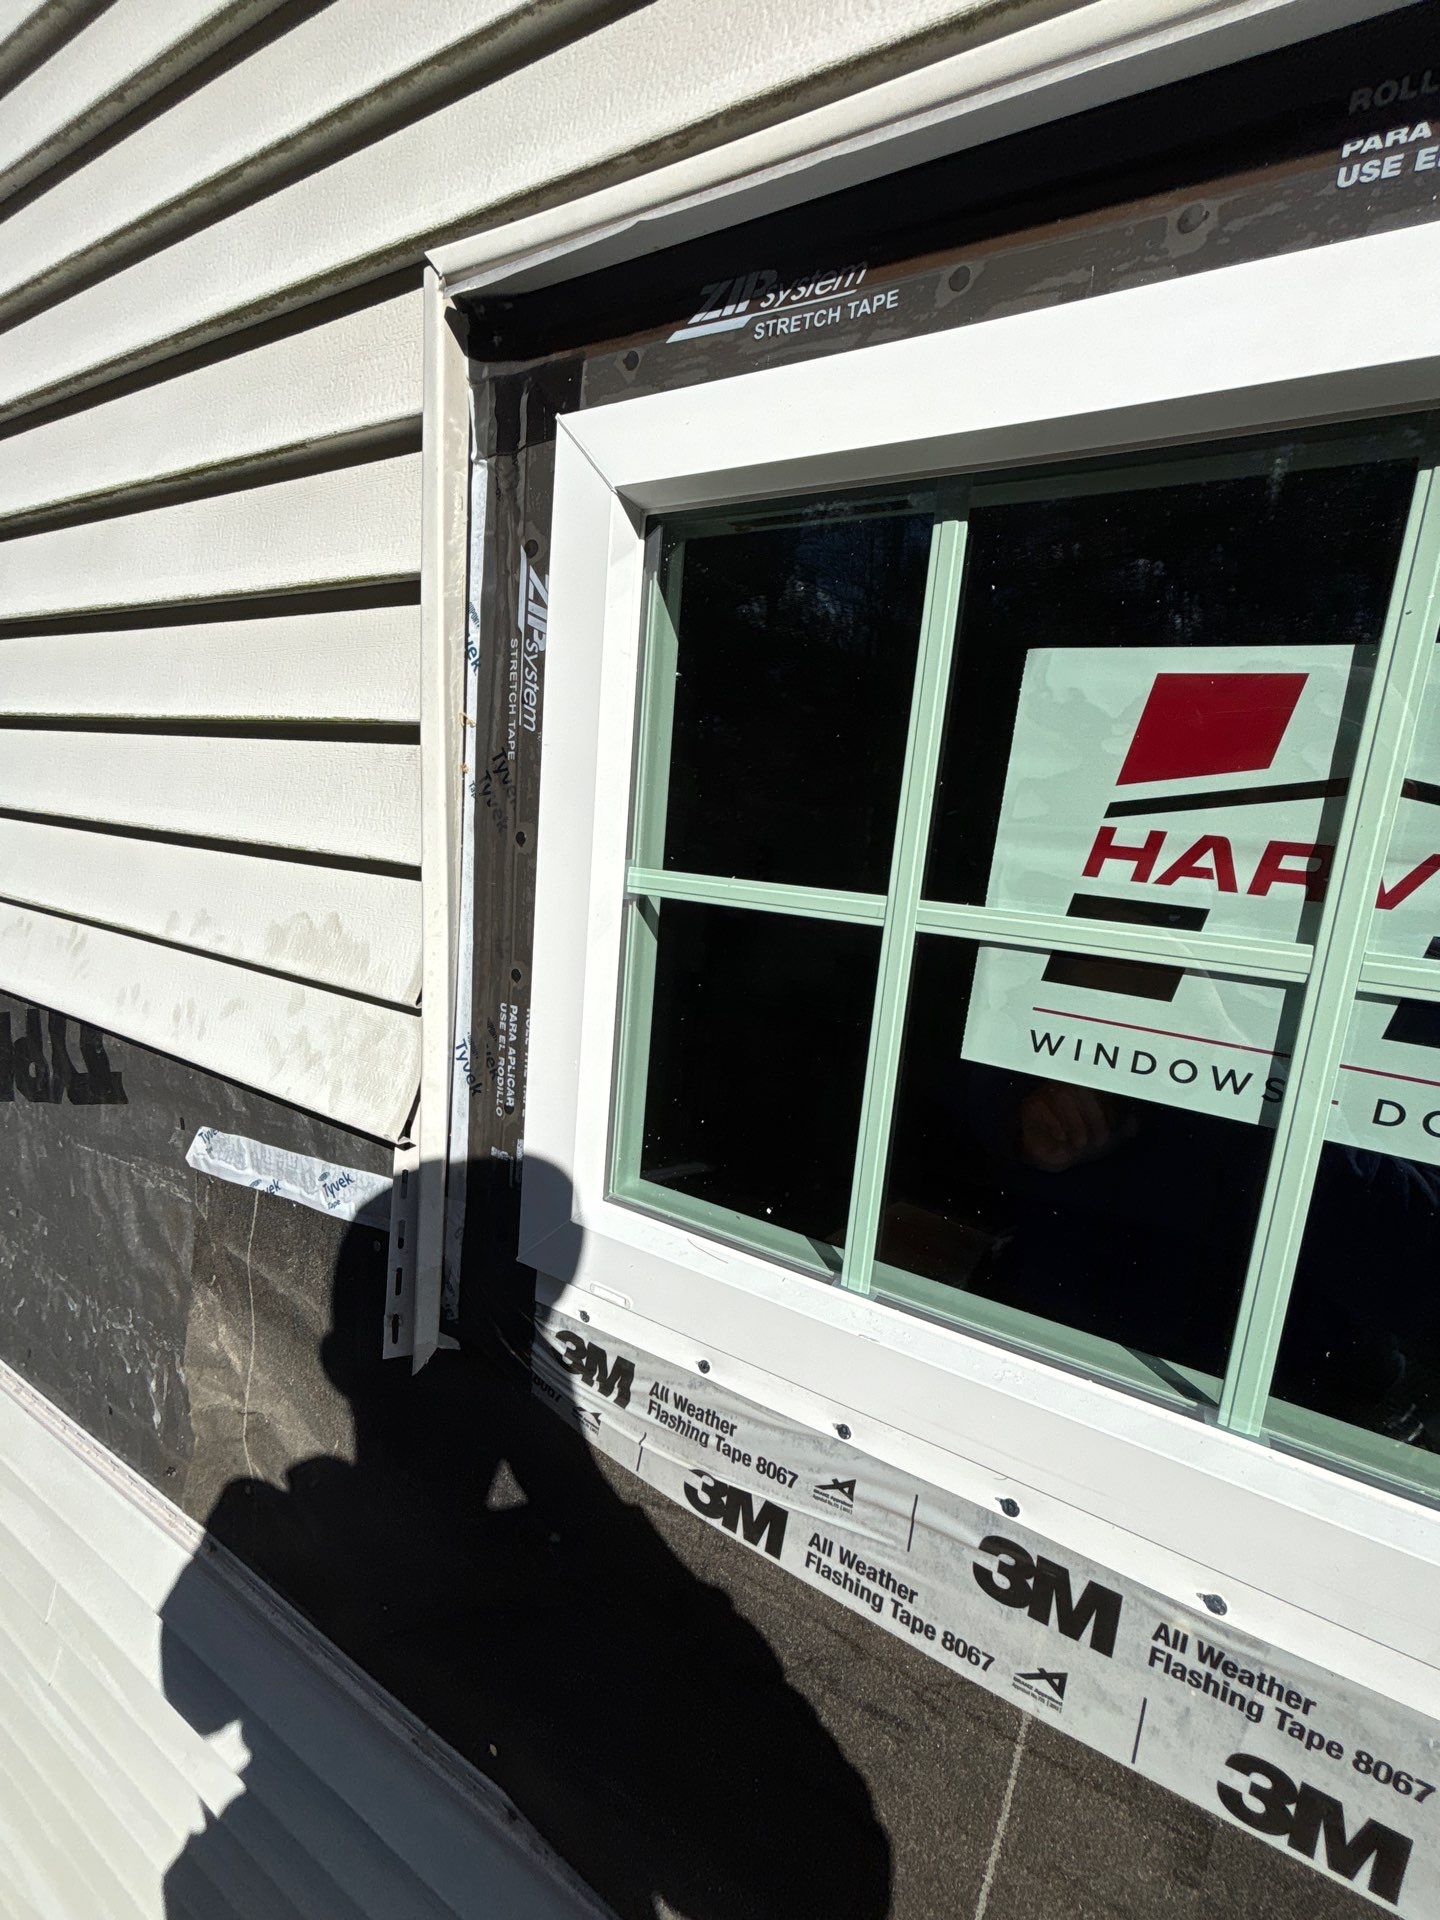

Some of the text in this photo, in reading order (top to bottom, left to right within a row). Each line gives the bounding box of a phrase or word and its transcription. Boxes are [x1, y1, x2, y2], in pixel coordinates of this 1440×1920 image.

[1348, 69, 1440, 117] ROLL
[1336, 145, 1440, 189] USE E
[1341, 121, 1433, 159] PARA
[687, 269, 778, 325] ZIP
[753, 288, 900, 340] STRETCH TAPE
[523, 565, 549, 732] ZIP system
[507, 638, 518, 761] STRETCH TAPE
[455, 1038, 482, 1097] Tyvek
[496, 1002, 507, 1117] USE EL RODILLO
[506, 1004, 518, 1107] PARA APLICAR
[1029, 1029, 1288, 1105] WINDOWS
[322, 1171, 355, 1199] Tyvek
[555, 1330, 636, 1410] 3M
[648, 1381, 738, 1438] All Weather
[647, 1398, 799, 1489] Flashing Tape 8067
[683, 1469, 789, 1560] 3M
[808, 1532, 919, 1605] All Weather
[972, 1534, 1124, 1659] 3M
[804, 1551, 996, 1672] Flashing Tape 8067
[1151, 1622, 1318, 1716] All Weather
[1148, 1645, 1437, 1803] Flashing Tape 8067
[1215, 1753, 1414, 1906] 3M
